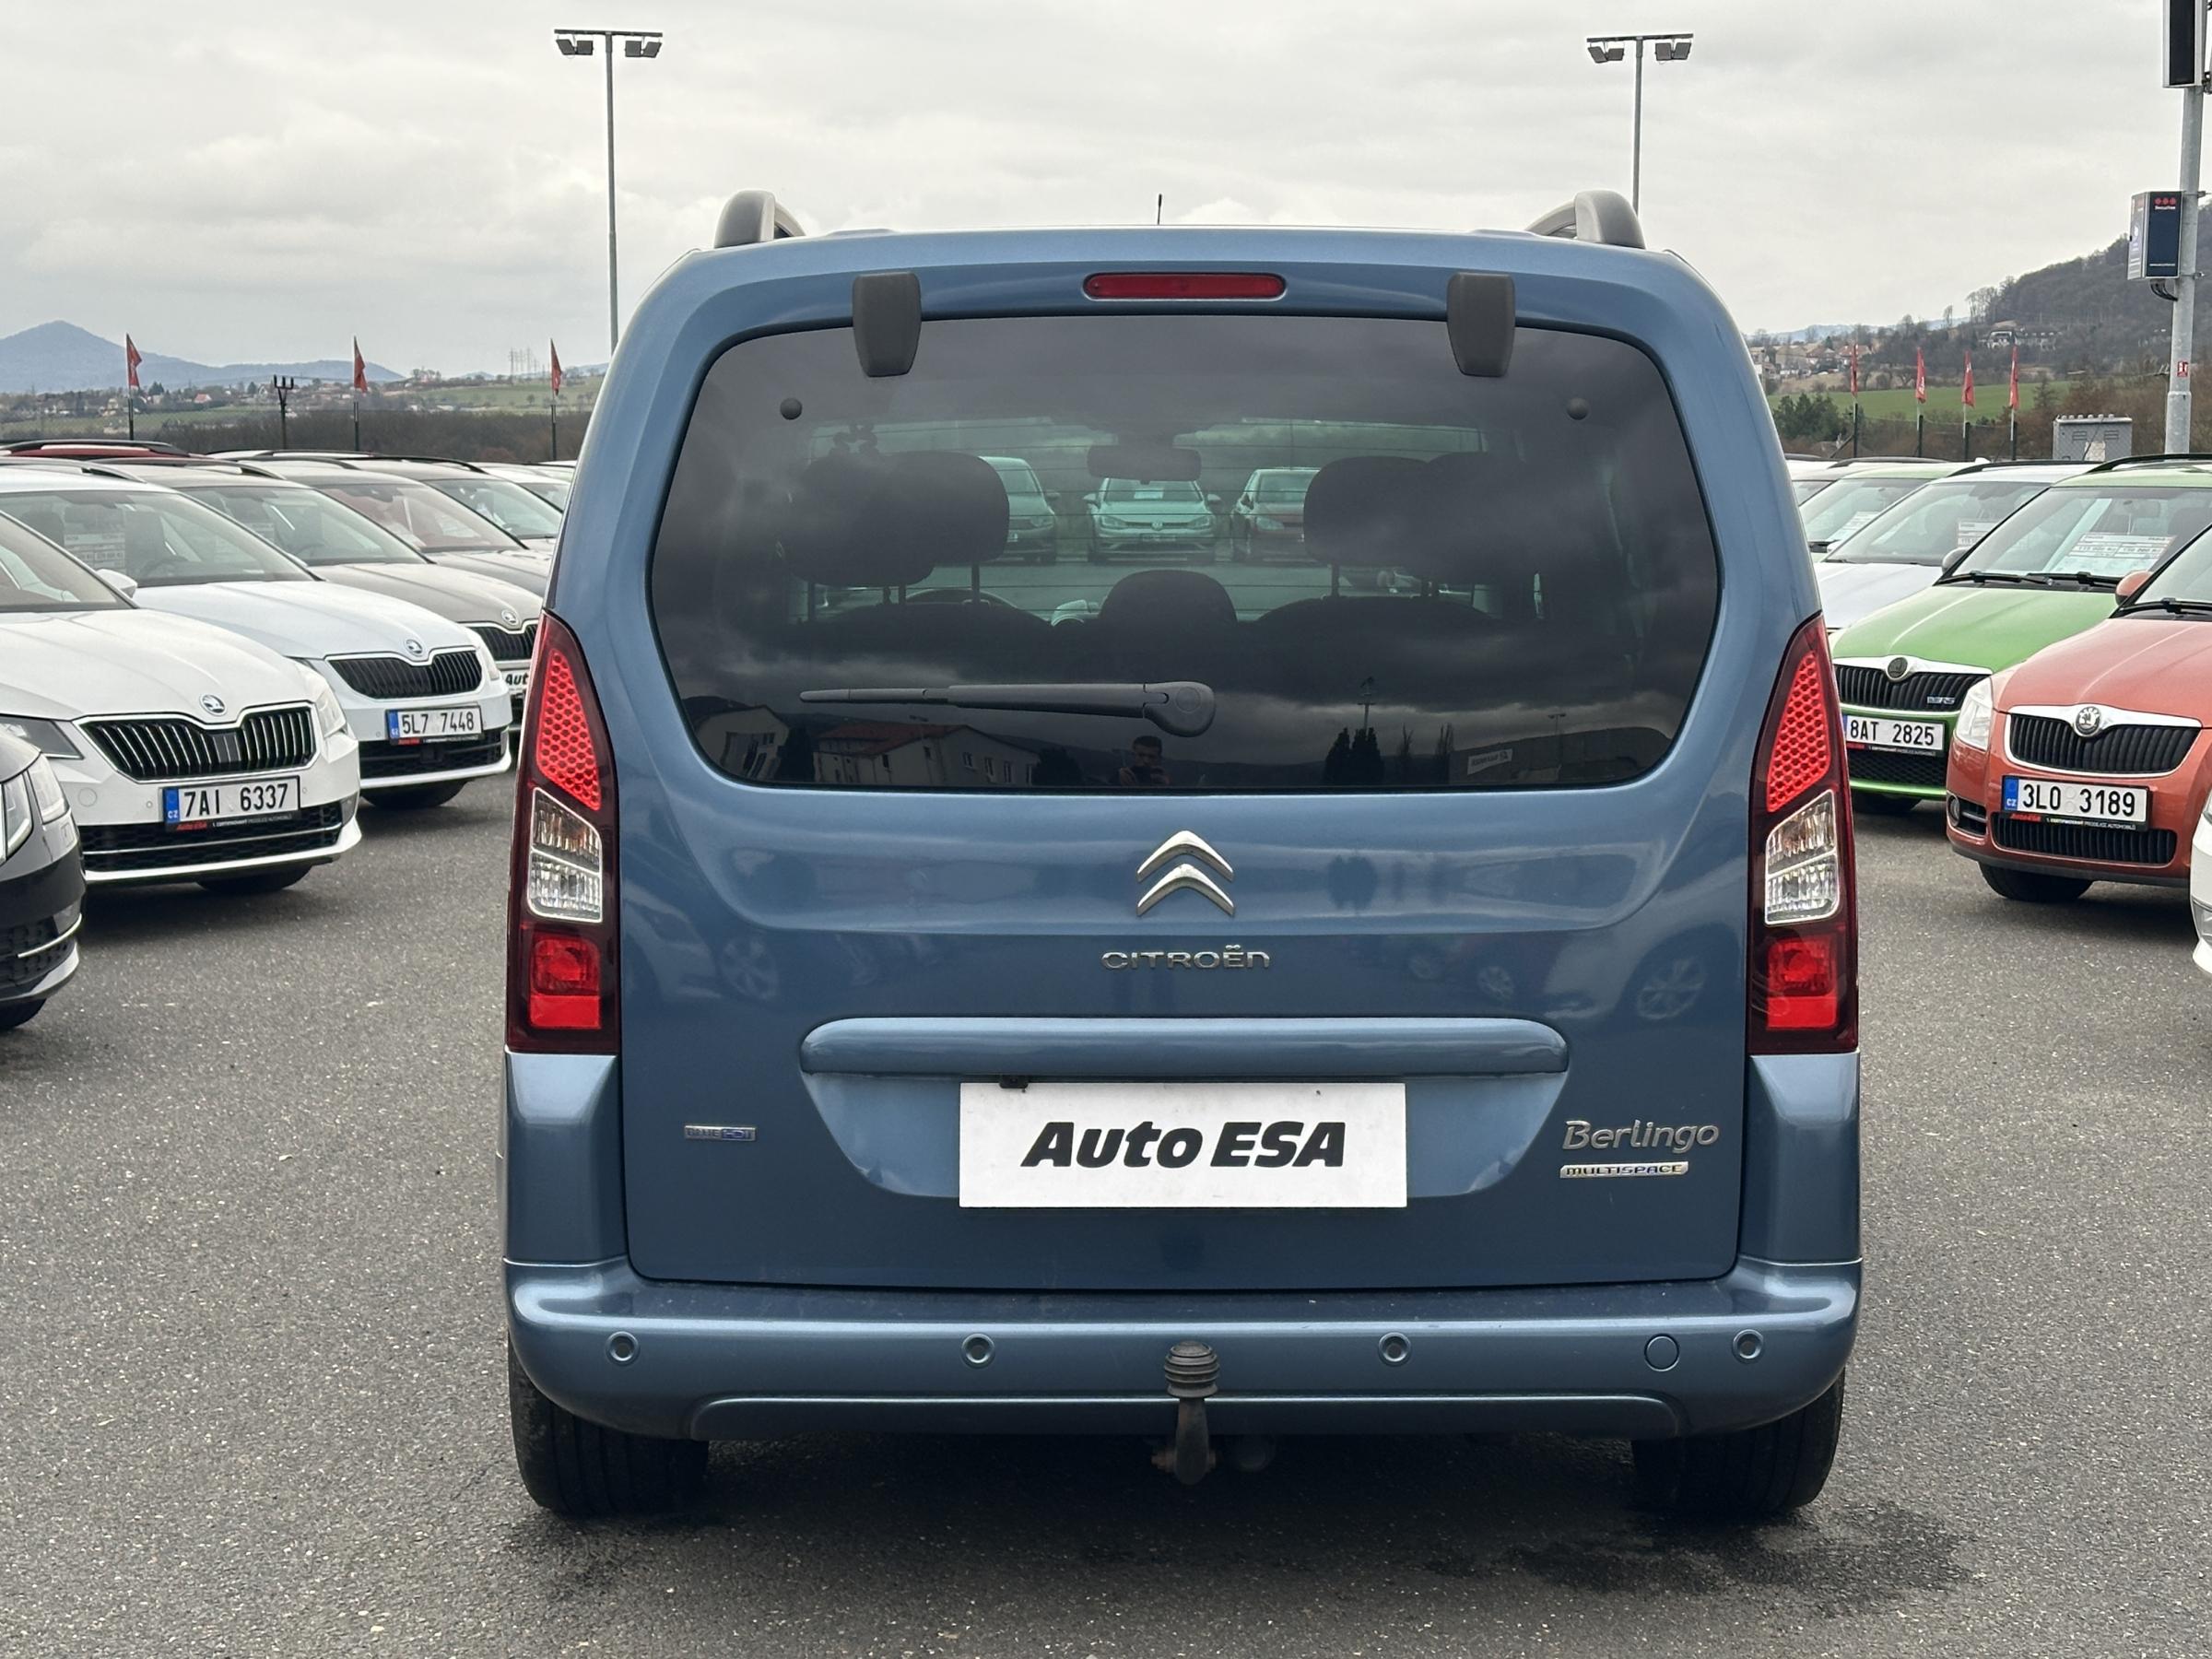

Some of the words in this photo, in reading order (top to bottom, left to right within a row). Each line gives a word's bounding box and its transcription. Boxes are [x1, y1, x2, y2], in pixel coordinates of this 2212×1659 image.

[505, 673, 529, 686] Aut
[402, 713, 429, 735] 5L7
[441, 712, 475, 732] 7448
[1850, 720, 1879, 741] 8AT
[1892, 724, 1935, 746] 2825
[167, 809, 179, 819] CZ
[240, 783, 288, 811] 6337
[2006, 798, 2017, 807] CZ
[2079, 788, 2136, 817] 3189
[1020, 1121, 1204, 1169] Auto
[1210, 1121, 1347, 1169] ESA
[1562, 1119, 1720, 1154] Berlingo
[1566, 1163, 1683, 1176] MULTISPACE
